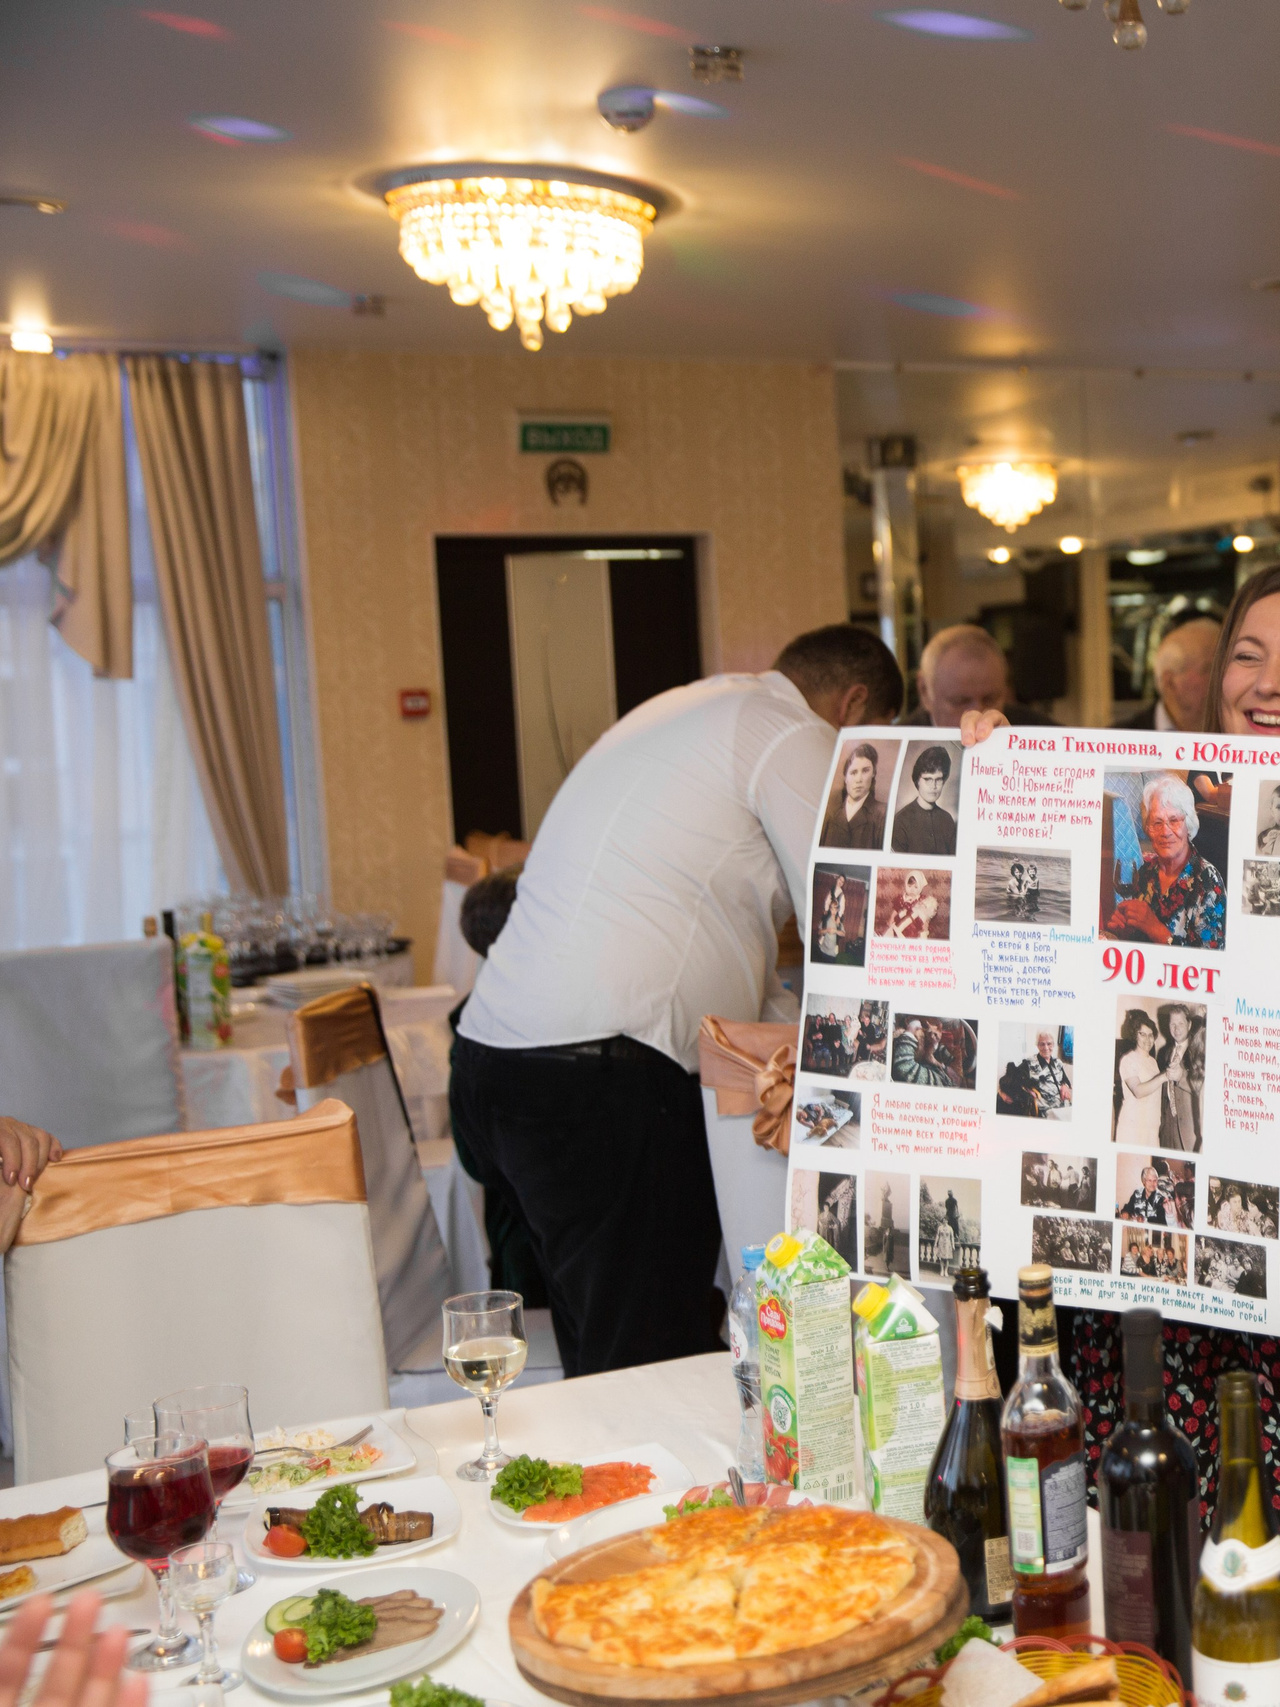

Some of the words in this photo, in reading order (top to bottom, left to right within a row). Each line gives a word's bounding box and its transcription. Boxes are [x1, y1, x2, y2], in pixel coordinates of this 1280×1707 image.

[1008, 734, 1057, 752] Раиса
[1062, 737, 1163, 759] Тихоновна,
[1176, 746, 1185, 760] с
[1102, 947, 1146, 986] 90
[1157, 962, 1221, 994] лет
